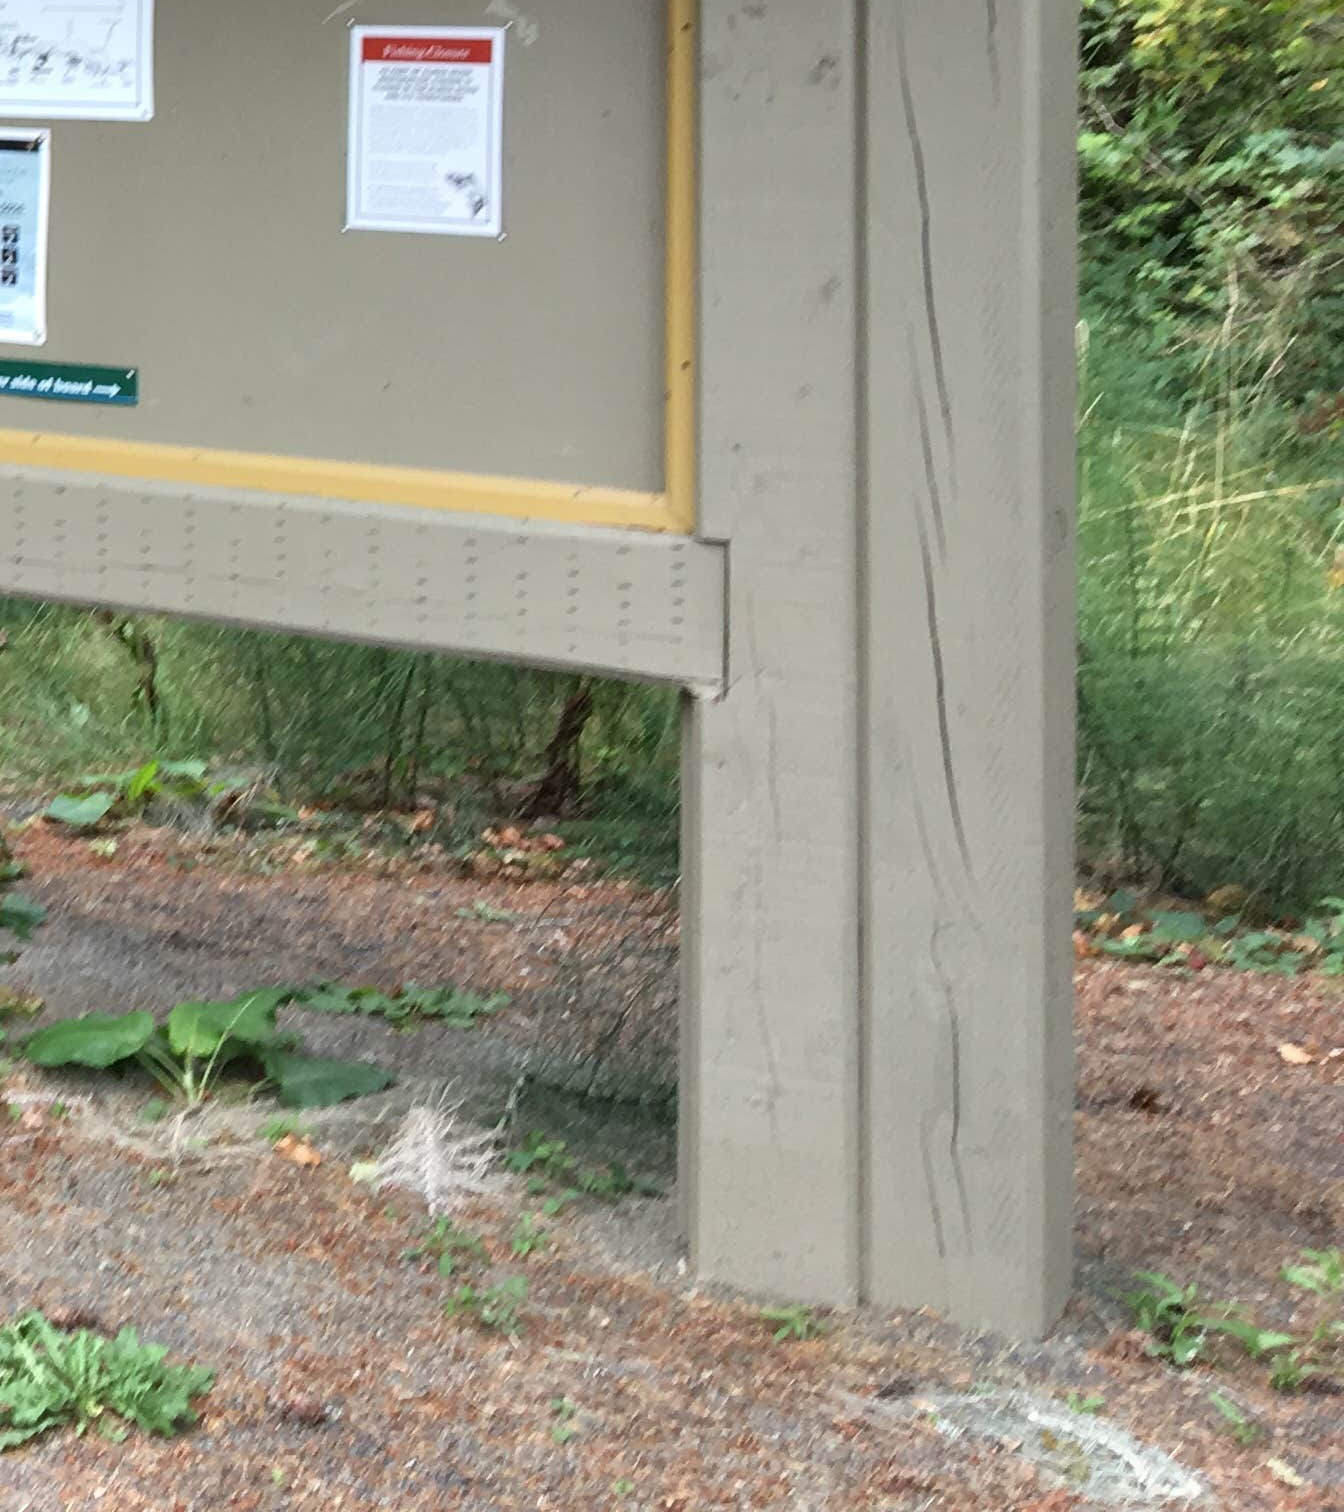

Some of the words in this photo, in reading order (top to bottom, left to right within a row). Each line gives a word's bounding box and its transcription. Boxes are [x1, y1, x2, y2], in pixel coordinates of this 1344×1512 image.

[12, 374, 37, 391] side
[37, 376, 55, 393] of
[53, 376, 94, 395] board
